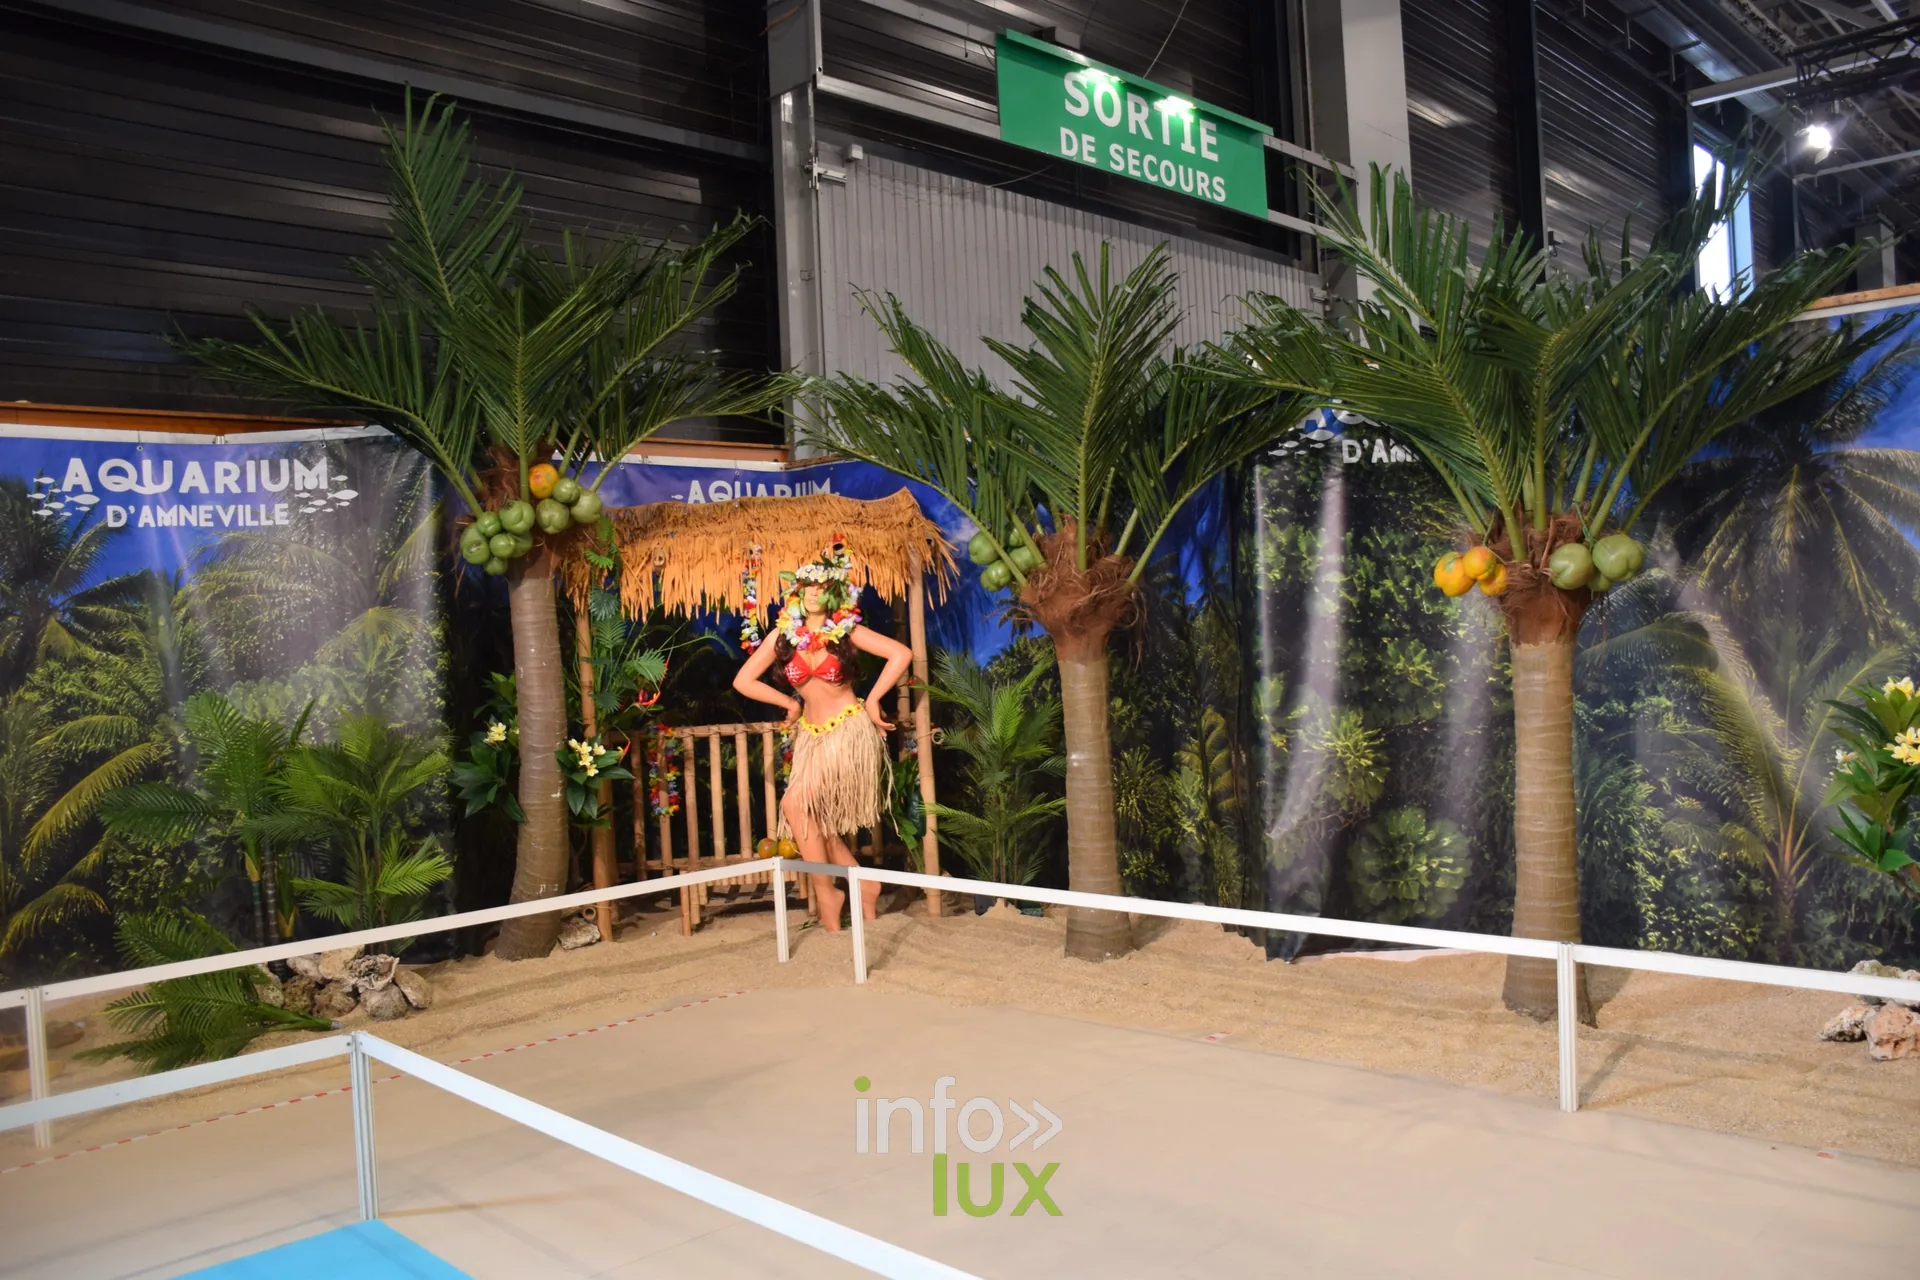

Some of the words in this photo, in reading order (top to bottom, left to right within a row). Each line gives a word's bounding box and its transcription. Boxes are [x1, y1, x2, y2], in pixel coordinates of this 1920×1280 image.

[1063, 70, 1219, 163] SORTIE
[1060, 126, 1097, 165] DE
[1109, 143, 1226, 203] SECOURS
[61, 457, 328, 495] AQUARIUM
[107, 503, 290, 528] D'AMNEVILLE
